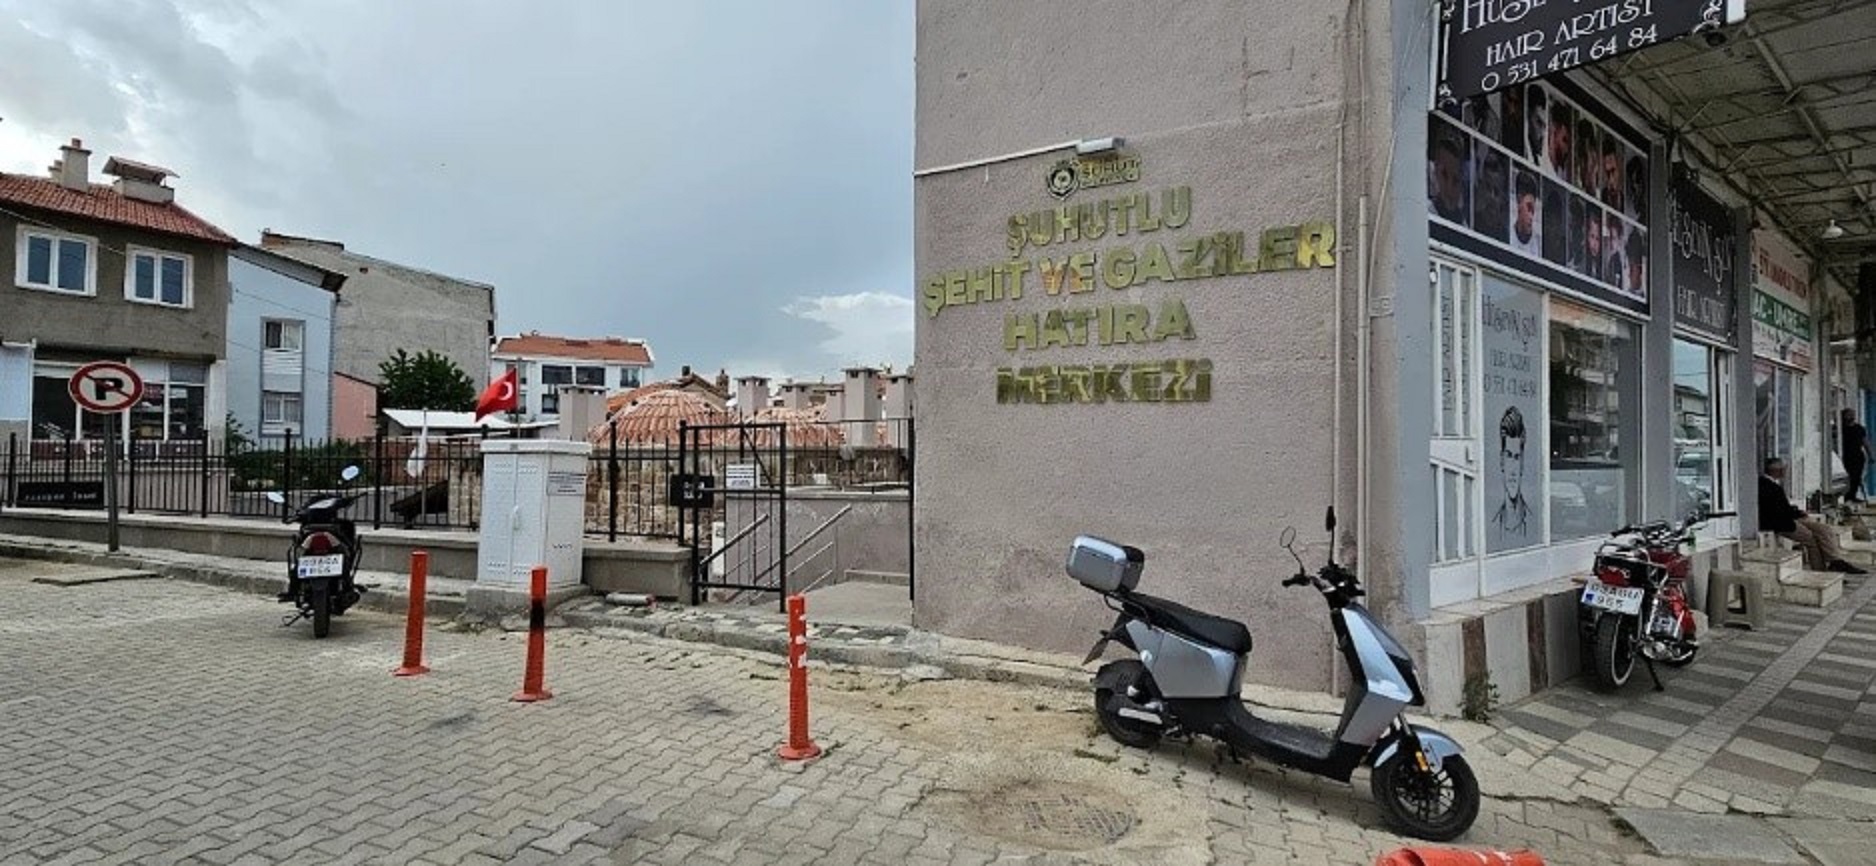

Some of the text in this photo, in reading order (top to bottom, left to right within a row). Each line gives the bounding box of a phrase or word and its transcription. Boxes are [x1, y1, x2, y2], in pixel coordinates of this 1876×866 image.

[1486, 0, 1653, 67] HAIR ARTIST
[1507, 60, 1539, 85] 531
[1547, 48, 1581, 71] 471
[1590, 35, 1618, 60] 64
[1628, 24, 1658, 48] 84
[1007, 186, 1191, 258] ŞUHUTLU
[923, 220, 1336, 319] ŞEHİT VE GAZİLER
[1004, 299, 1196, 350] HATIRA
[94, 377, 123, 400] P
[997, 358, 1214, 404] MERKEZİ
